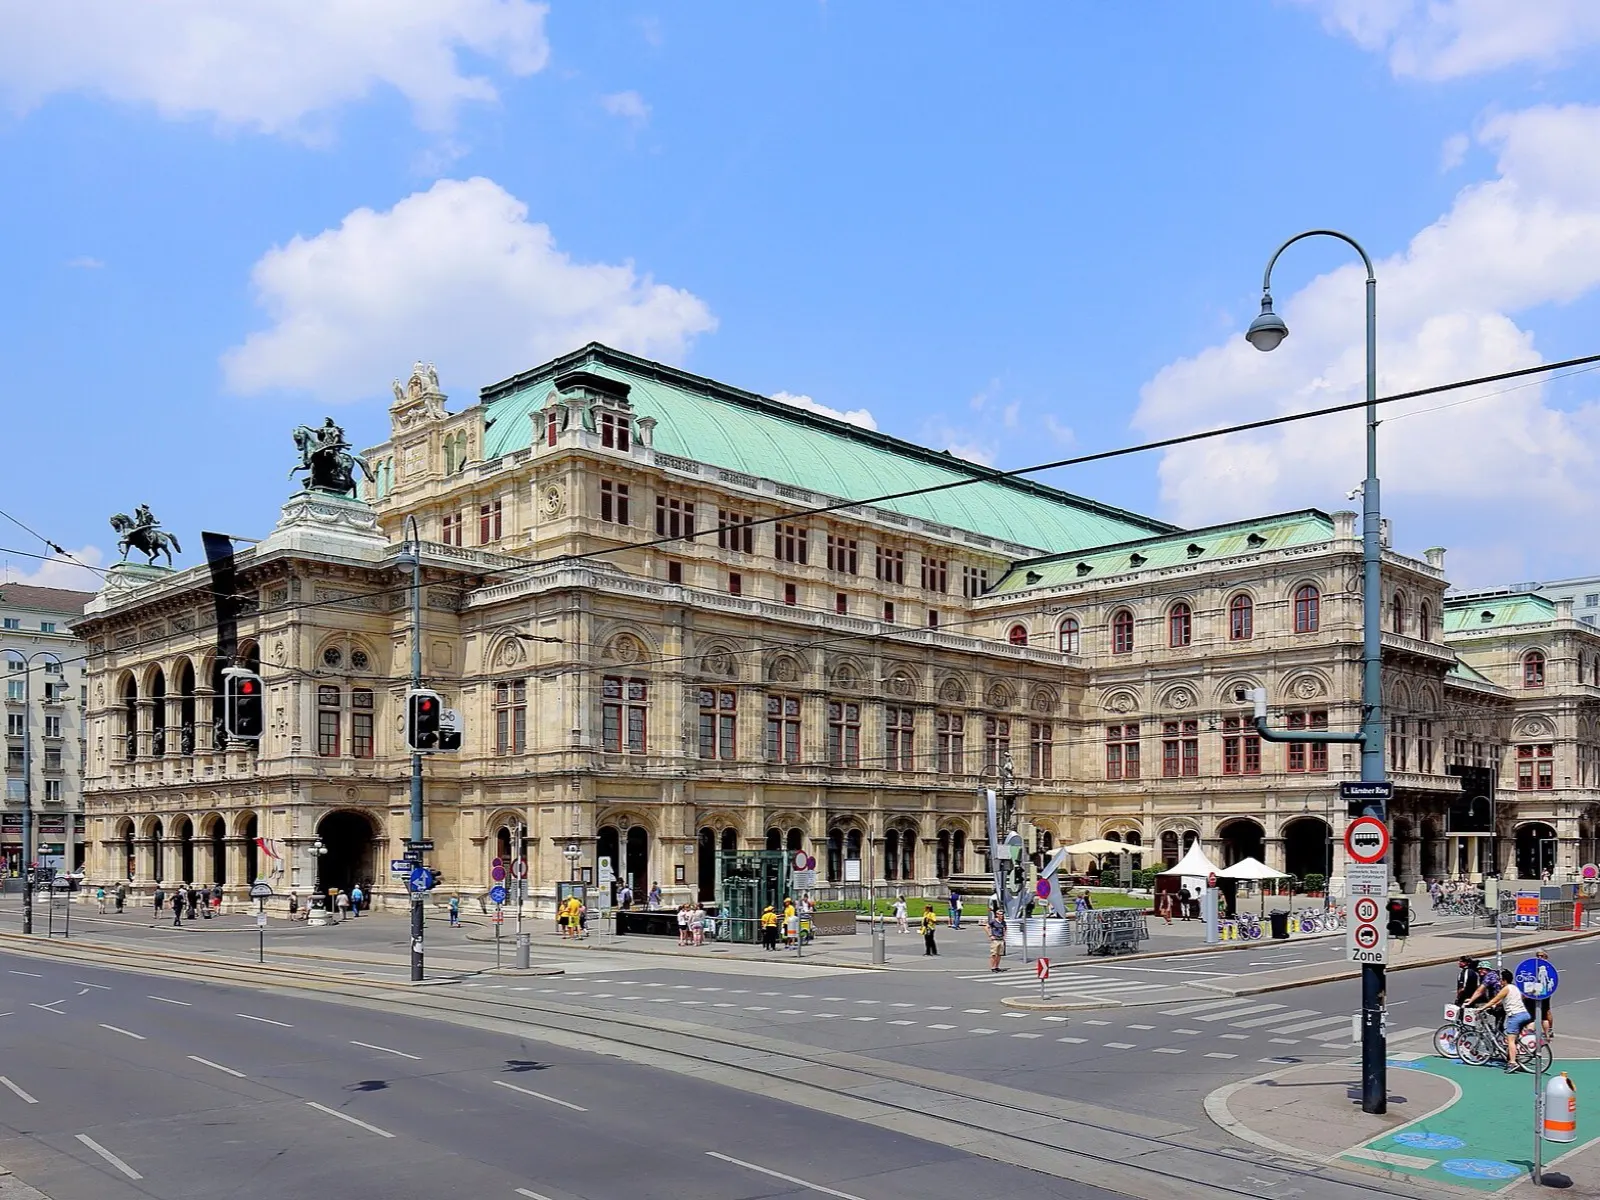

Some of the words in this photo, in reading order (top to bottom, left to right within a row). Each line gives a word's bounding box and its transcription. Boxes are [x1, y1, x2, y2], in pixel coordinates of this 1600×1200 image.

[1375, 787, 1388, 795] Ring
[1361, 905, 1372, 917] 30
[1352, 948, 1382, 962] Zone
